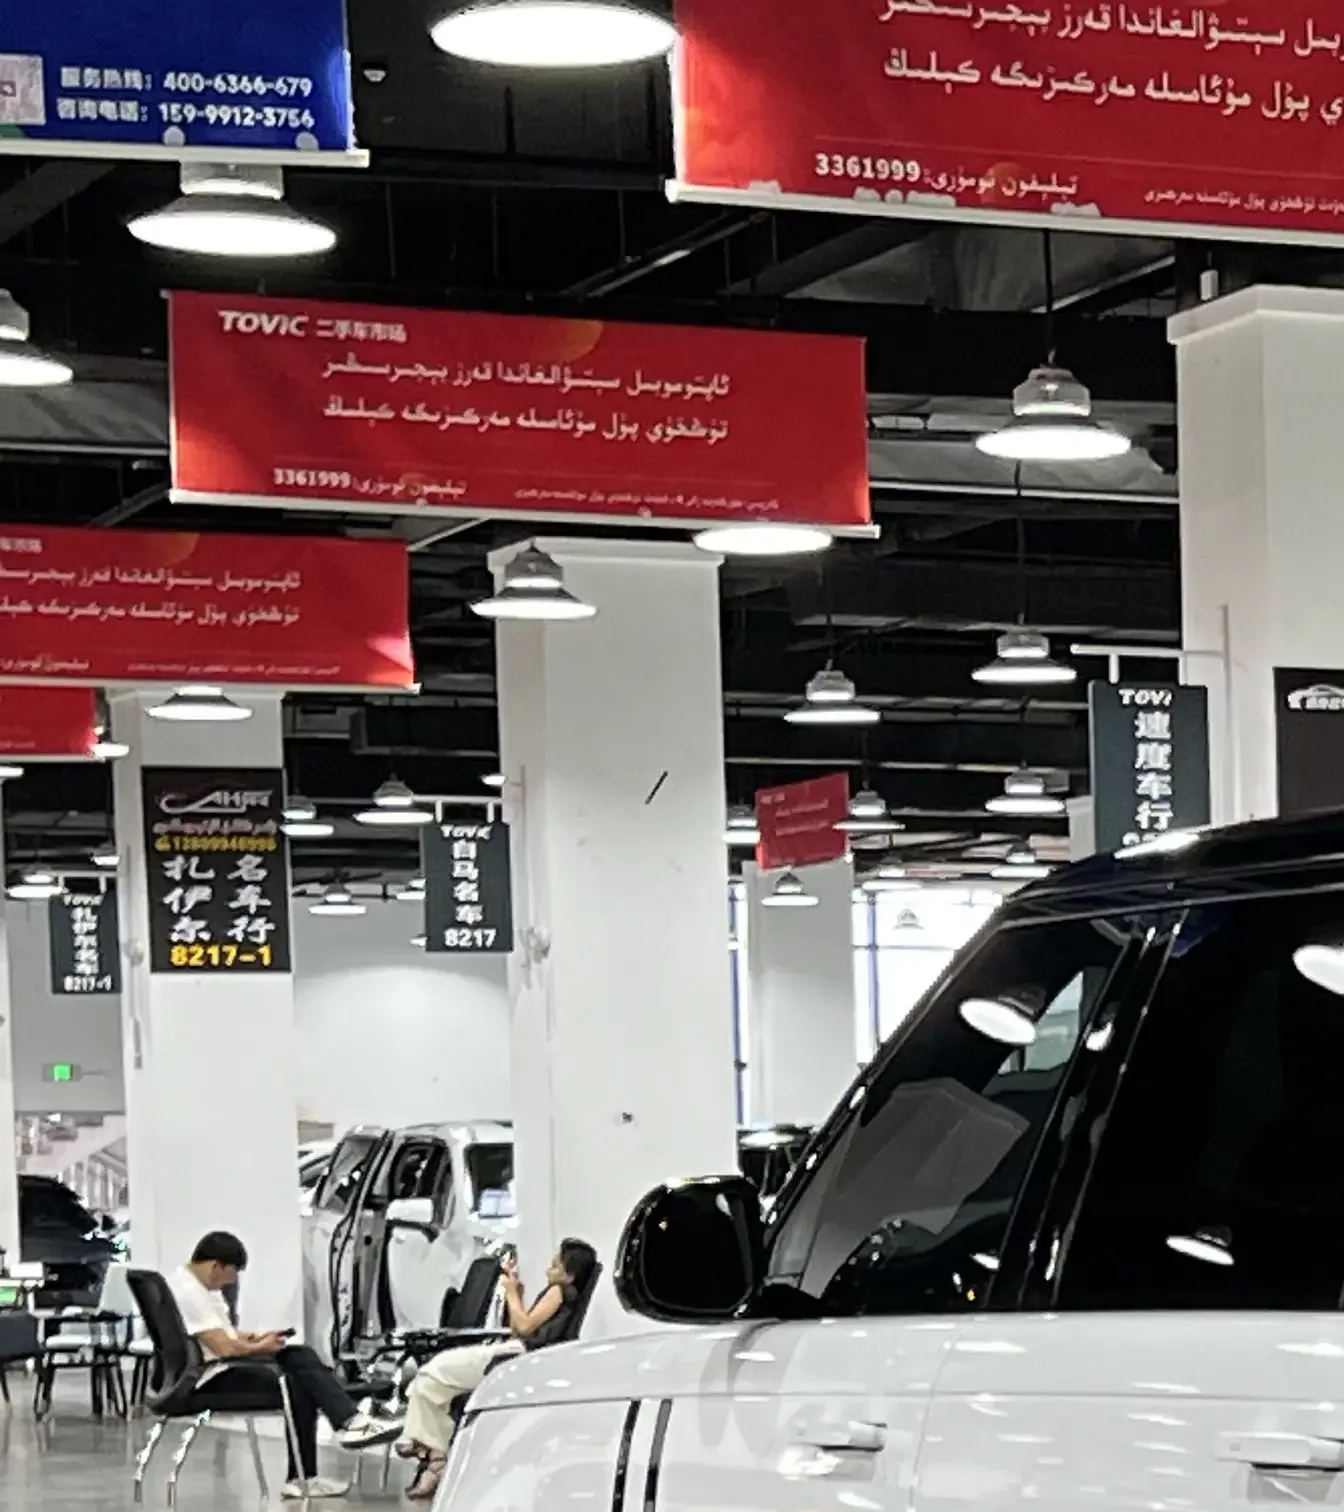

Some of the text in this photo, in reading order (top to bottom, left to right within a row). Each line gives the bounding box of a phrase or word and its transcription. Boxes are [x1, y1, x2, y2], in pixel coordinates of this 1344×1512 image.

[163, 71, 314, 98] 400-6366-679
[157, 102, 315, 129] 159-9912-3756
[814, 152, 921, 183] 3361999
[217, 309, 310, 337] TOVIC
[444, 927, 497, 948] 8217
[170, 944, 272, 967] 8217-1
